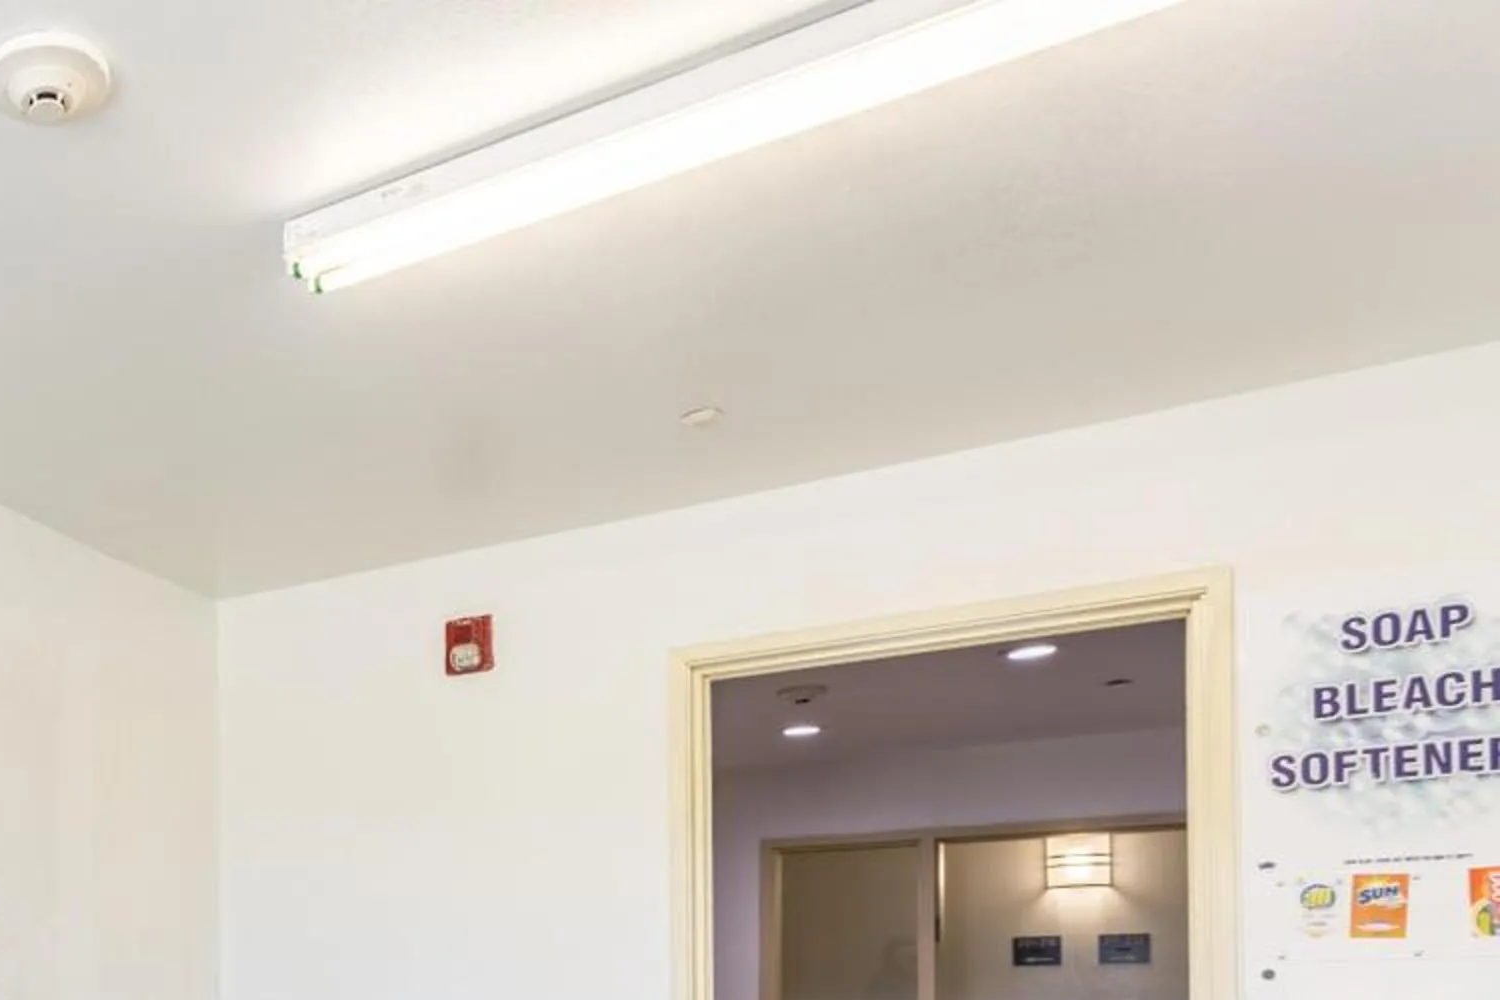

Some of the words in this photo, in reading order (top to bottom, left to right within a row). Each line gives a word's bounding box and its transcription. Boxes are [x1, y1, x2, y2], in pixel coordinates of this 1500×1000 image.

[1340, 604, 1470, 651] SOAP
[1313, 667, 1500, 720] BLEACH
[1358, 885, 1400, 905] SUN
